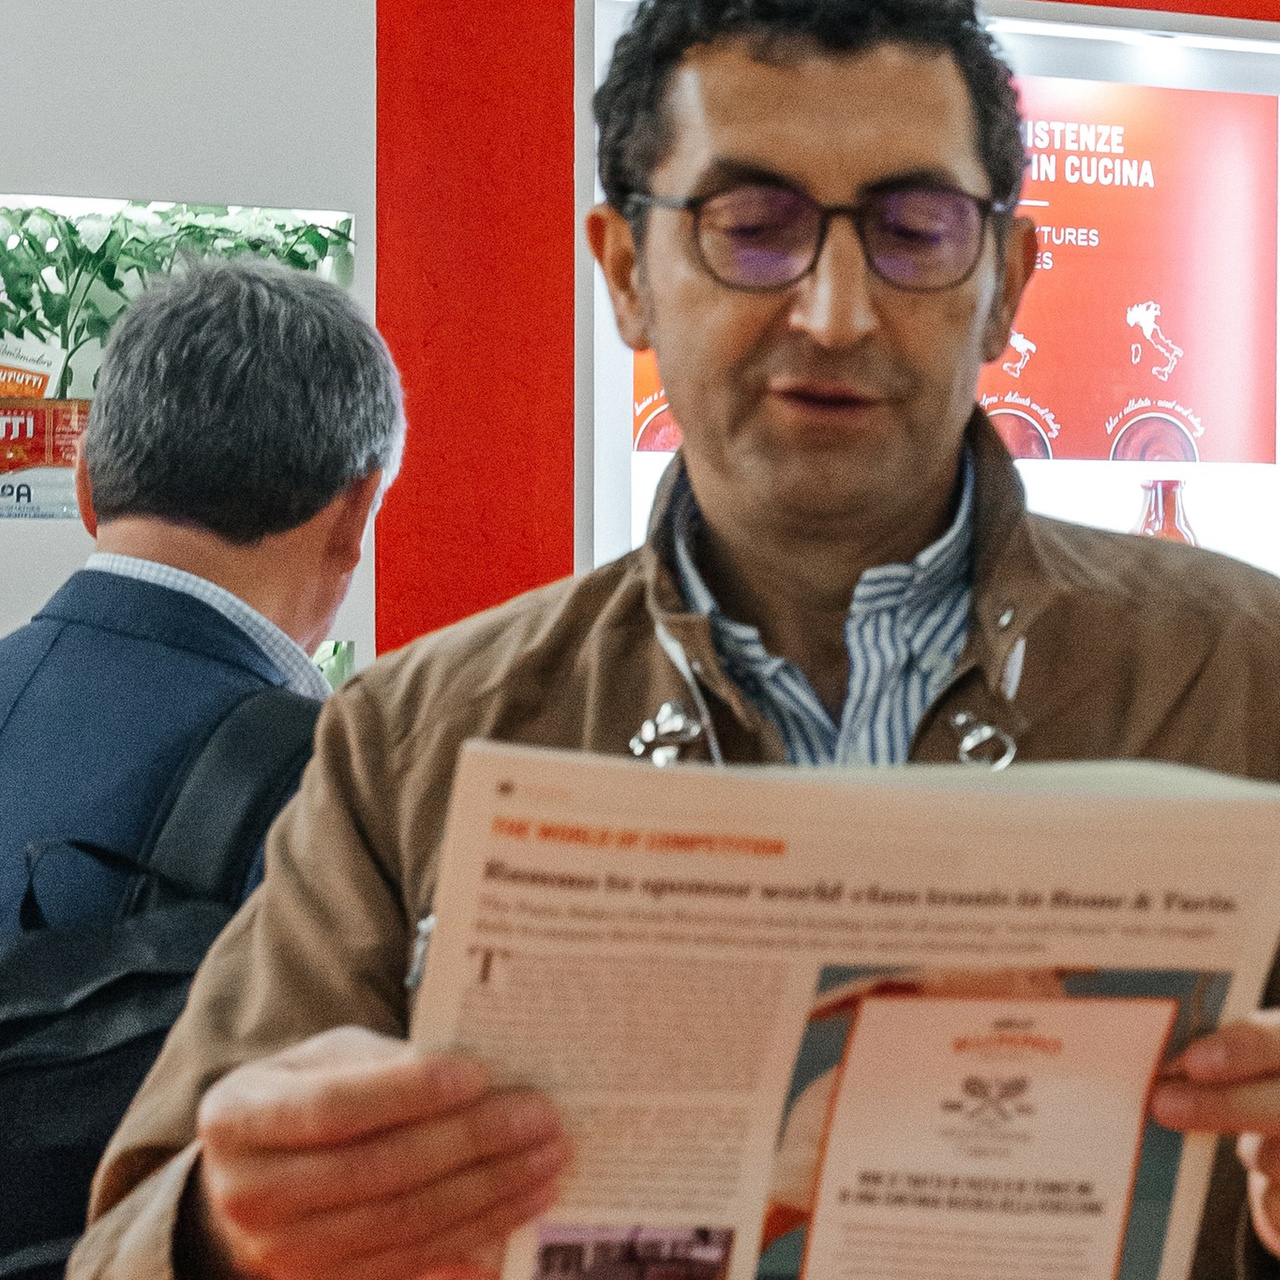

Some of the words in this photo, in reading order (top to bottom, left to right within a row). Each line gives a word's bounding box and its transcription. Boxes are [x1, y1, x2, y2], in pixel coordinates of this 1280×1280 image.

[1025, 119, 1125, 155] ISTENZE
[1030, 153, 1057, 183] IN
[1064, 155, 1155, 188] CUCINA
